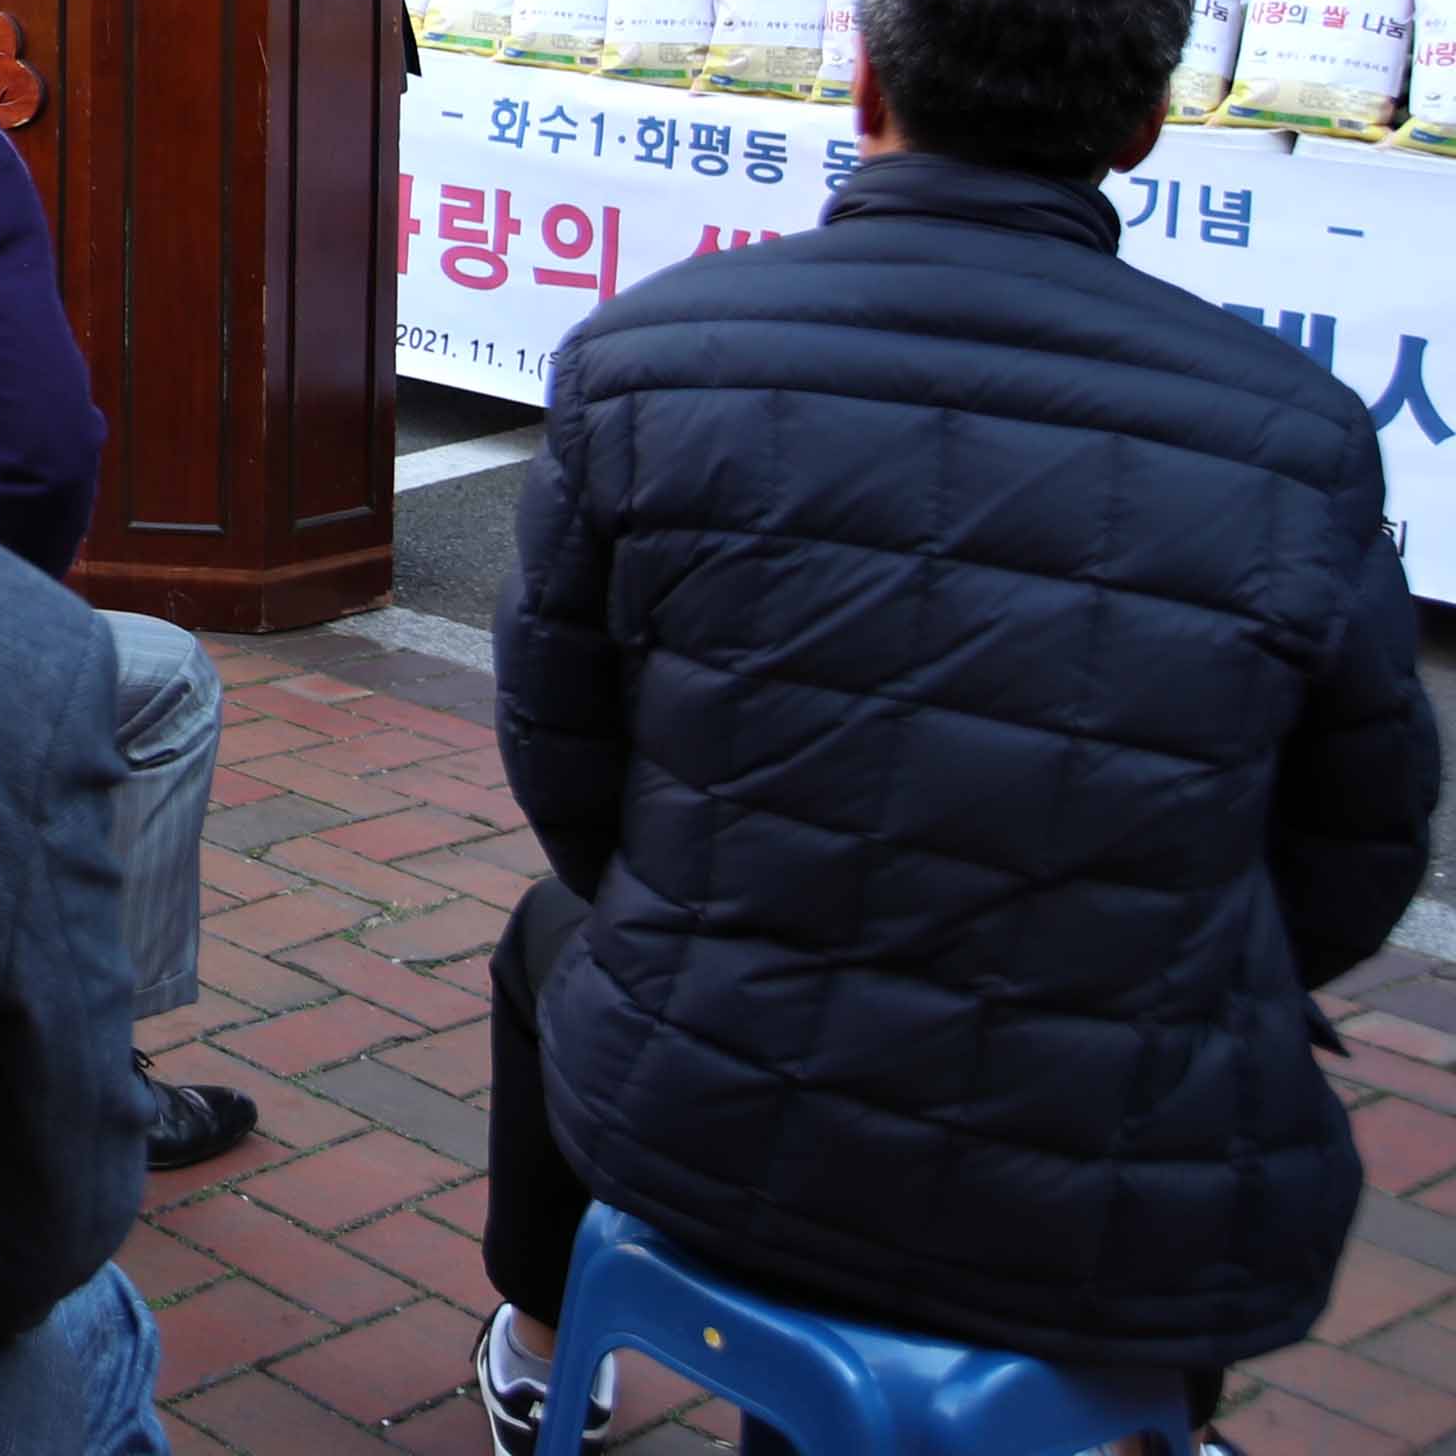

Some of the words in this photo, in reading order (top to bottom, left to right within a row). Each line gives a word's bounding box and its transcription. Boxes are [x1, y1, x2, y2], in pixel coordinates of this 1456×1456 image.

[1249, 1, 1309, 25] 사랑의
[1322, 4, 1349, 30] 쌀
[1361, 12, 1409, 40] 나눔
[488, 97, 788, 185] 화수1·화평동
[1126, 176, 1254, 248] 기념
